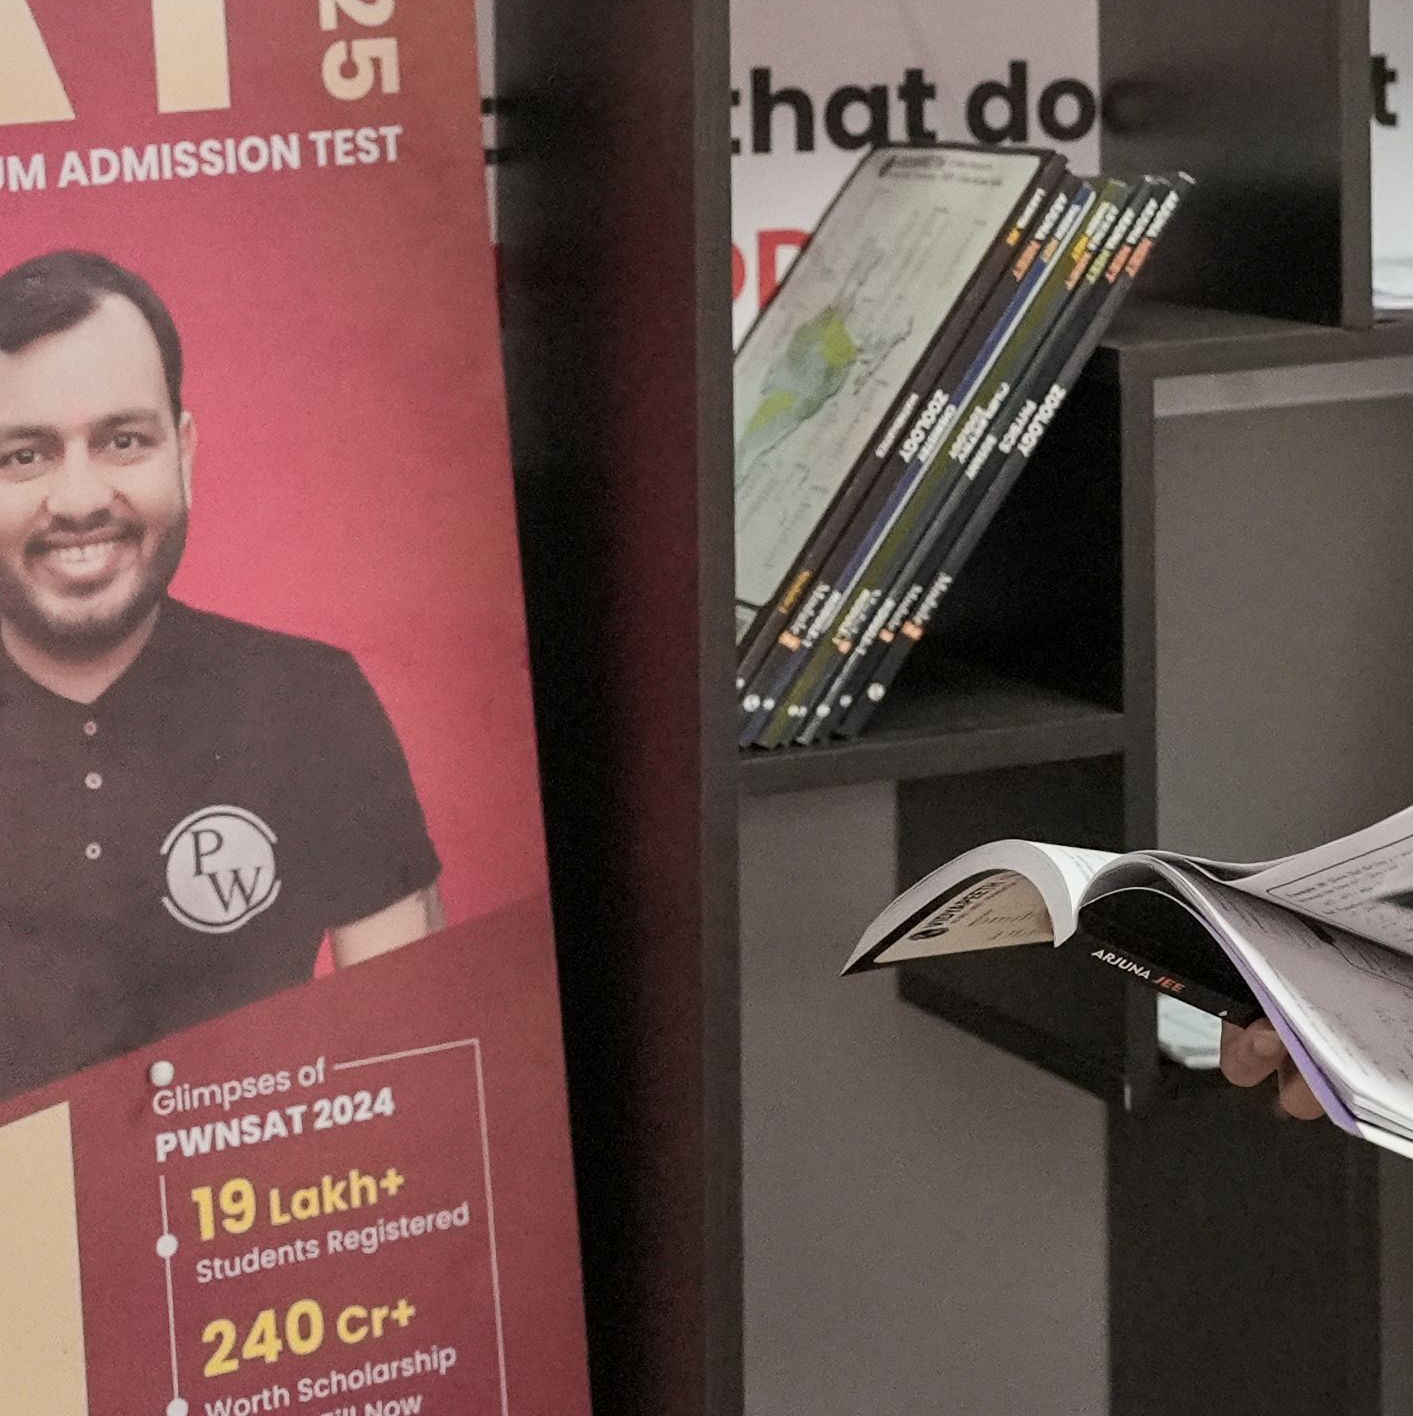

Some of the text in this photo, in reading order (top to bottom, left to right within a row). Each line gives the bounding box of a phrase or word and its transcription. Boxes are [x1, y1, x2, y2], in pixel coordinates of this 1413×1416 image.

[57, 132, 300, 188] ADMISSION
[308, 125, 403, 167] TEST
[900, 389, 949, 462] ZOOLOGY
[1018, 385, 1066, 457] ZOOLOGY
[1091, 949, 1186, 994] ARJUNA JEE
[152, 1056, 326, 1116] Glimpses of
[156, 1086, 395, 1163] PWNSAT 2024
[191, 1168, 404, 1241] 19 Lakh+
[196, 1200, 470, 1283] Students Registered
[202, 1298, 416, 1378] 240 Cr+
[205, 1345, 457, 1416] Worth Scholarship
